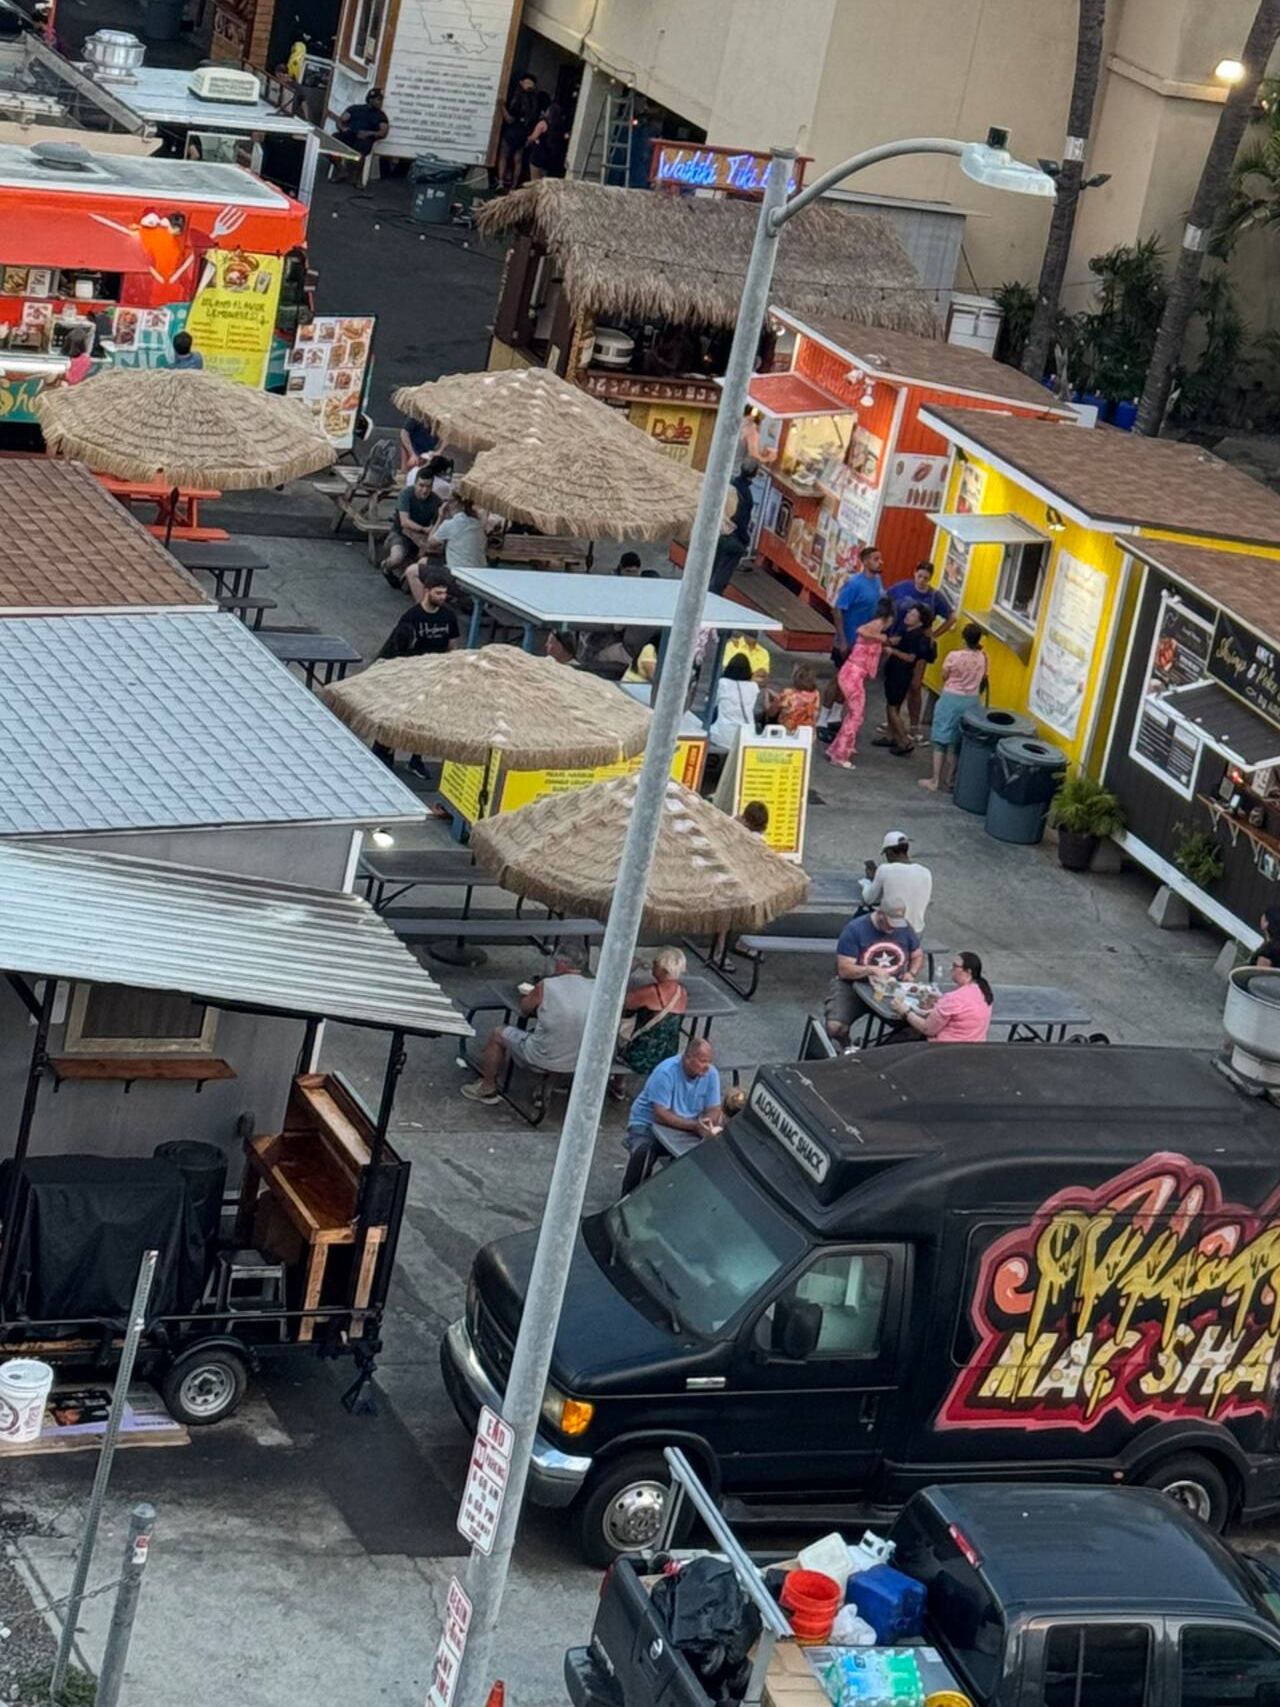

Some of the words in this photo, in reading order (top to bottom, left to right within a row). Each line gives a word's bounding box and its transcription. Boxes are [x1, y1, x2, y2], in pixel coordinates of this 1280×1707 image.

[658, 150, 718, 185] Waikiki
[727, 154, 758, 190] Tiki
[651, 416, 693, 440] Dole
[1246, 662, 1257, 679] &
[755, 1092, 781, 1128] ALOHA
[779, 1117, 799, 1146] MAC
[796, 1136, 824, 1174] SHACK
[979, 1331, 1143, 1399] MAC
[487, 1418, 506, 1448] END
